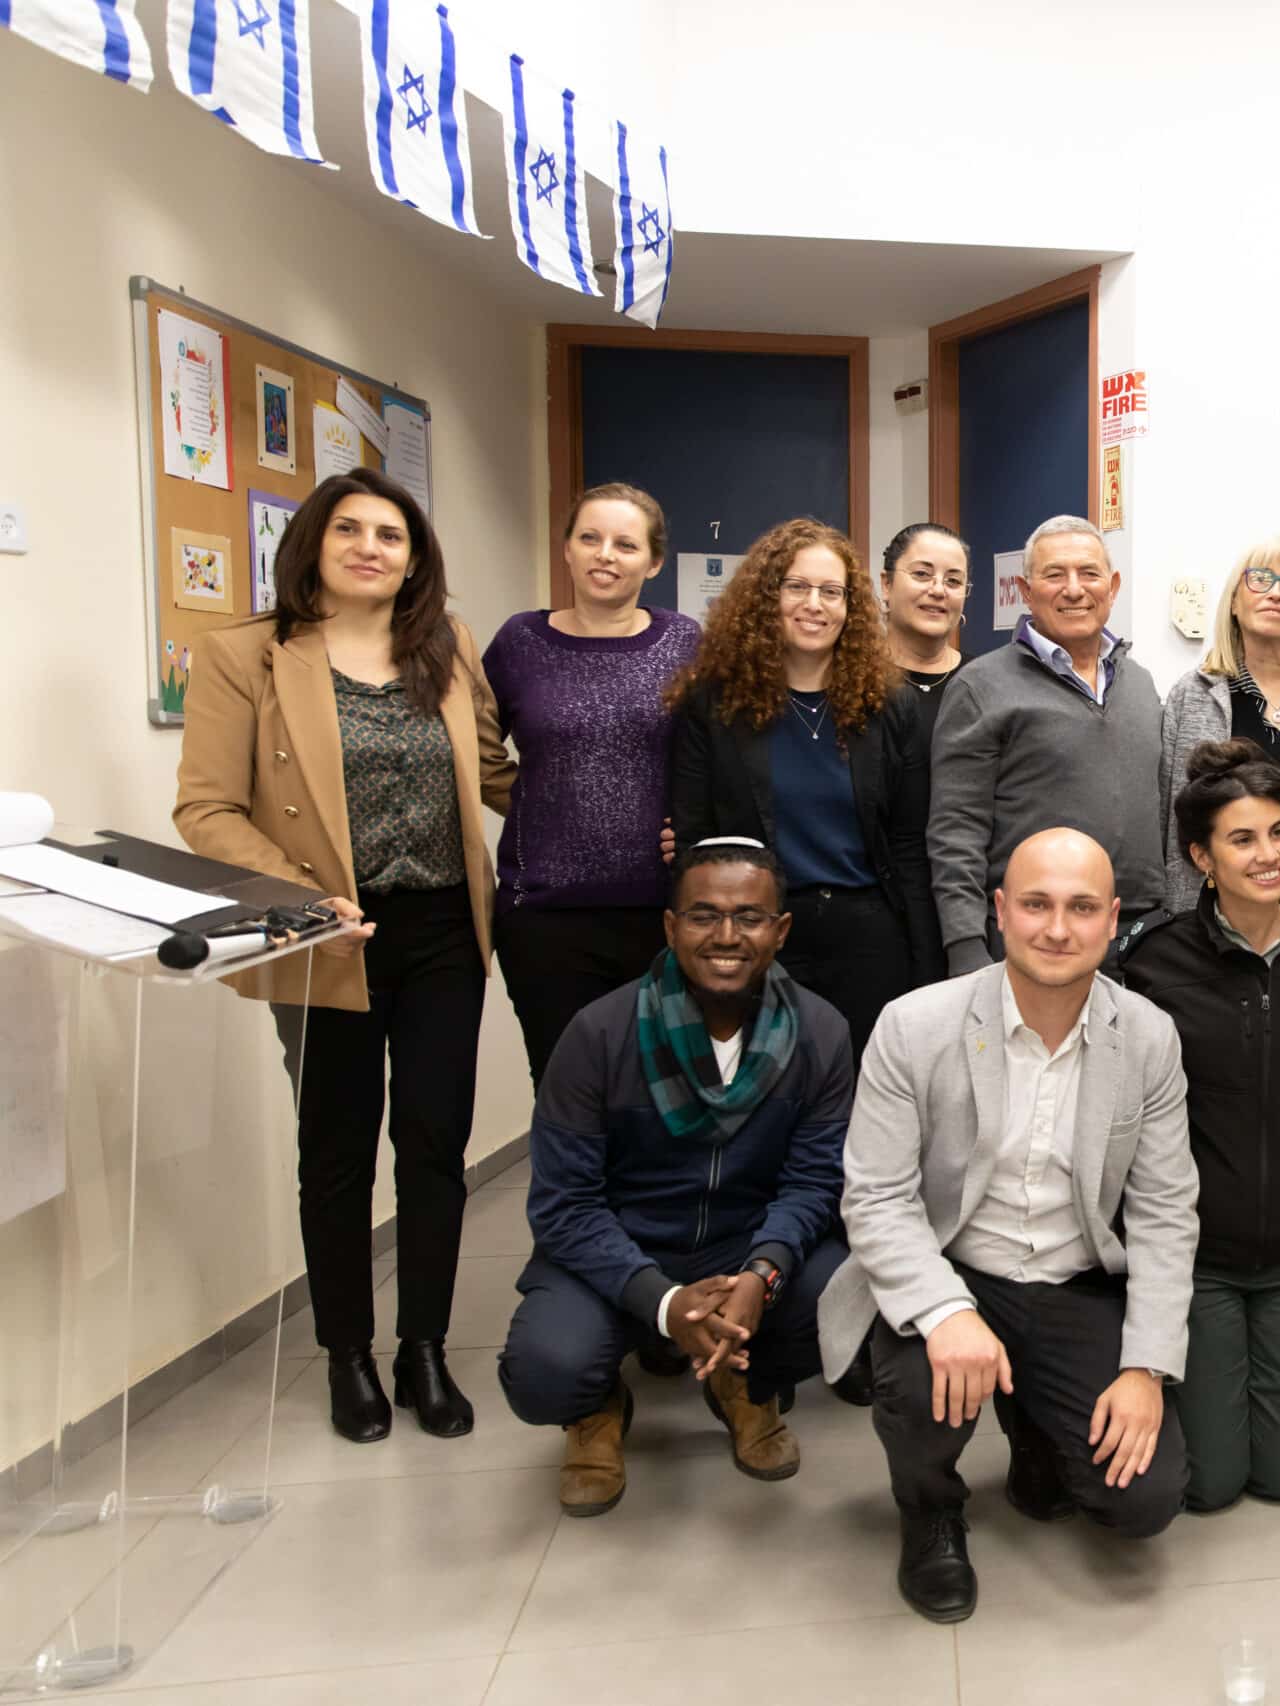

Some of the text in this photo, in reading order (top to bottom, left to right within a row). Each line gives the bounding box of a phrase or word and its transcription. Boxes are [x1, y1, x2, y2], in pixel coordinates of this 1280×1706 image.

[1103, 372, 1145, 398] אש
[1103, 394, 1147, 419] FIRE
[710, 521, 721, 540] 7
